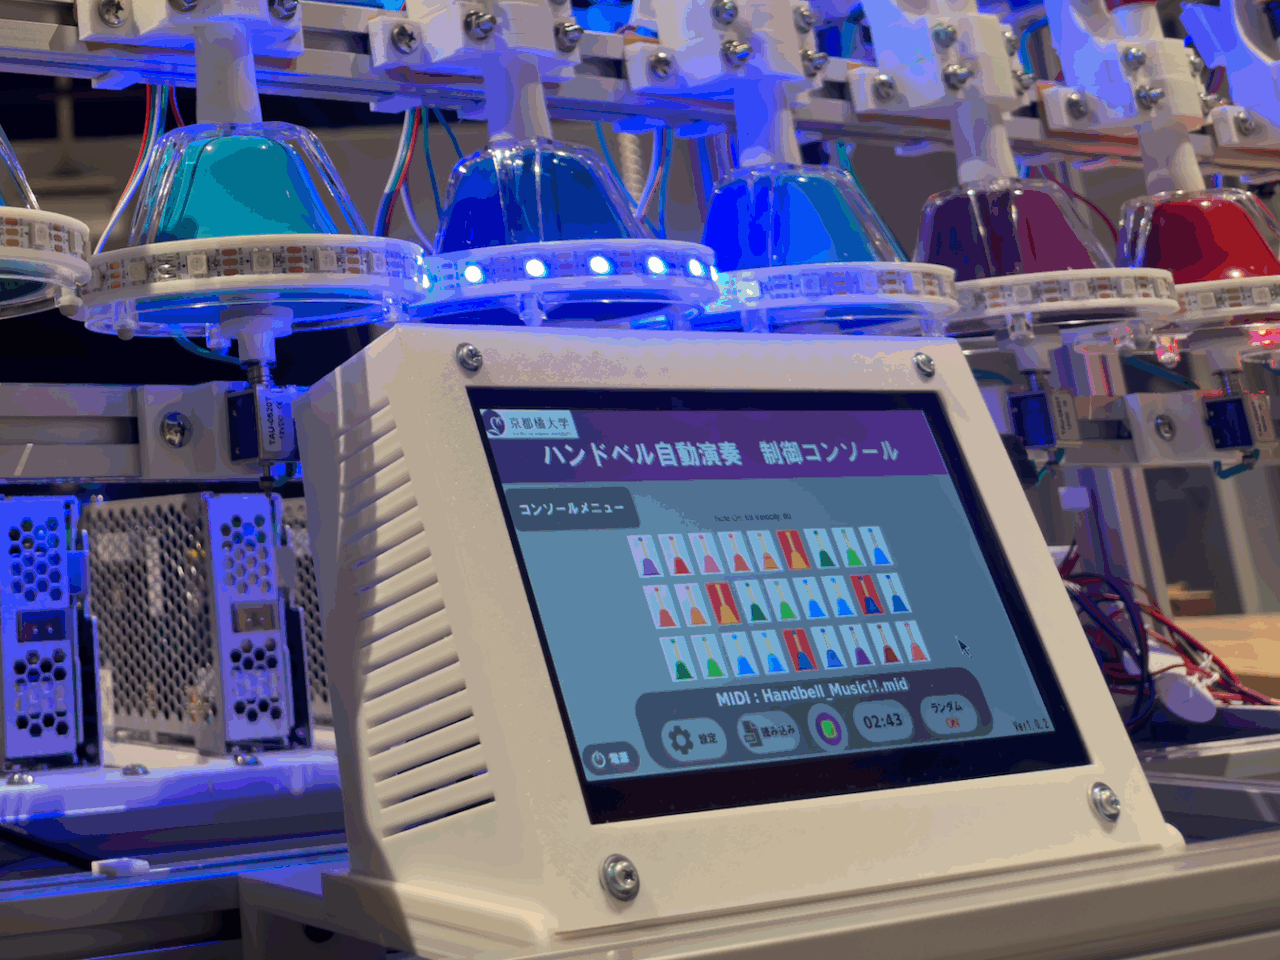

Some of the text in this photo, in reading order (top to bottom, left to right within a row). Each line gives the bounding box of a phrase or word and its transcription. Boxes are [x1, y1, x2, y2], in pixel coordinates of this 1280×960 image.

[544, 440, 899, 468] ハンドベル自動演奏 制御コンソール
[519, 502, 624, 516] コンソールメニュー
[716, 690, 751, 707] MIDI
[761, 677, 908, 703] Handbell_Music!!.mid
[930, 701, 963, 714] ランダム
[863, 713, 903, 729] 02:43
